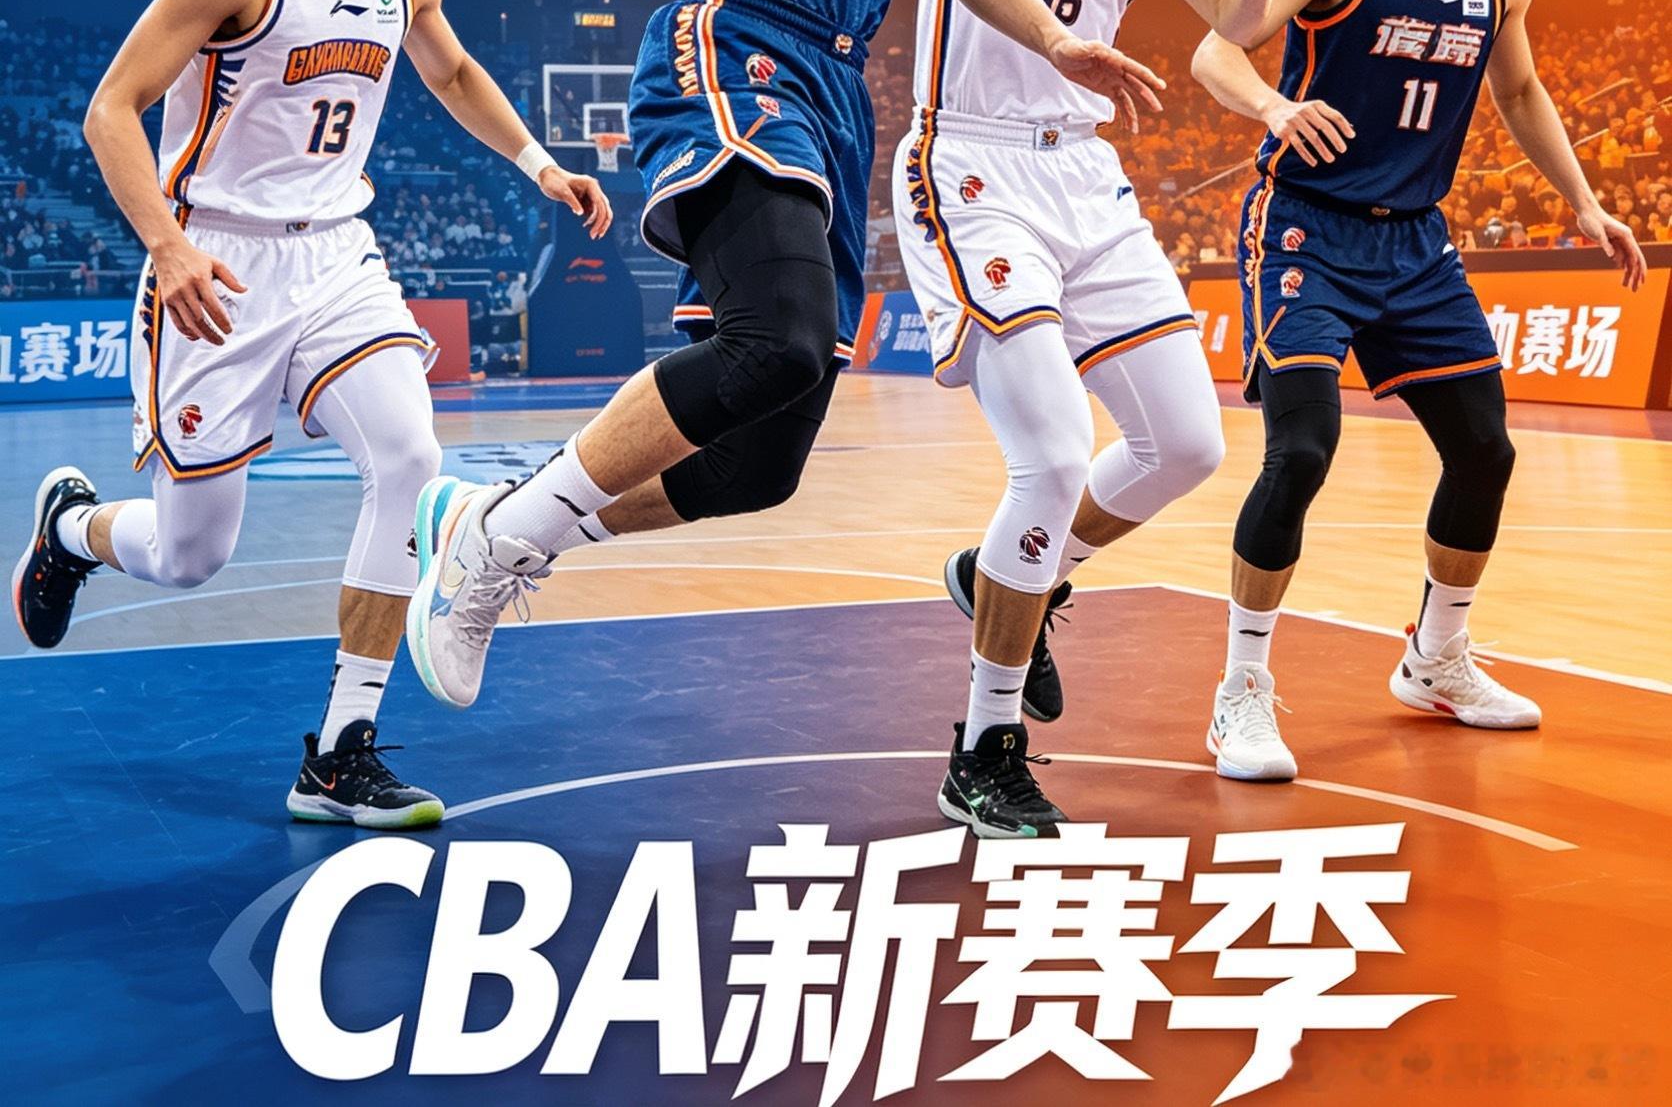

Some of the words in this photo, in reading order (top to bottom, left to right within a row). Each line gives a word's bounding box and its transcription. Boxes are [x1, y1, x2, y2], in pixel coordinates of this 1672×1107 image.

[306, 98, 356, 155] 13
[1398, 77, 1440, 131] 11
[0, 320, 128, 383] 赛场
